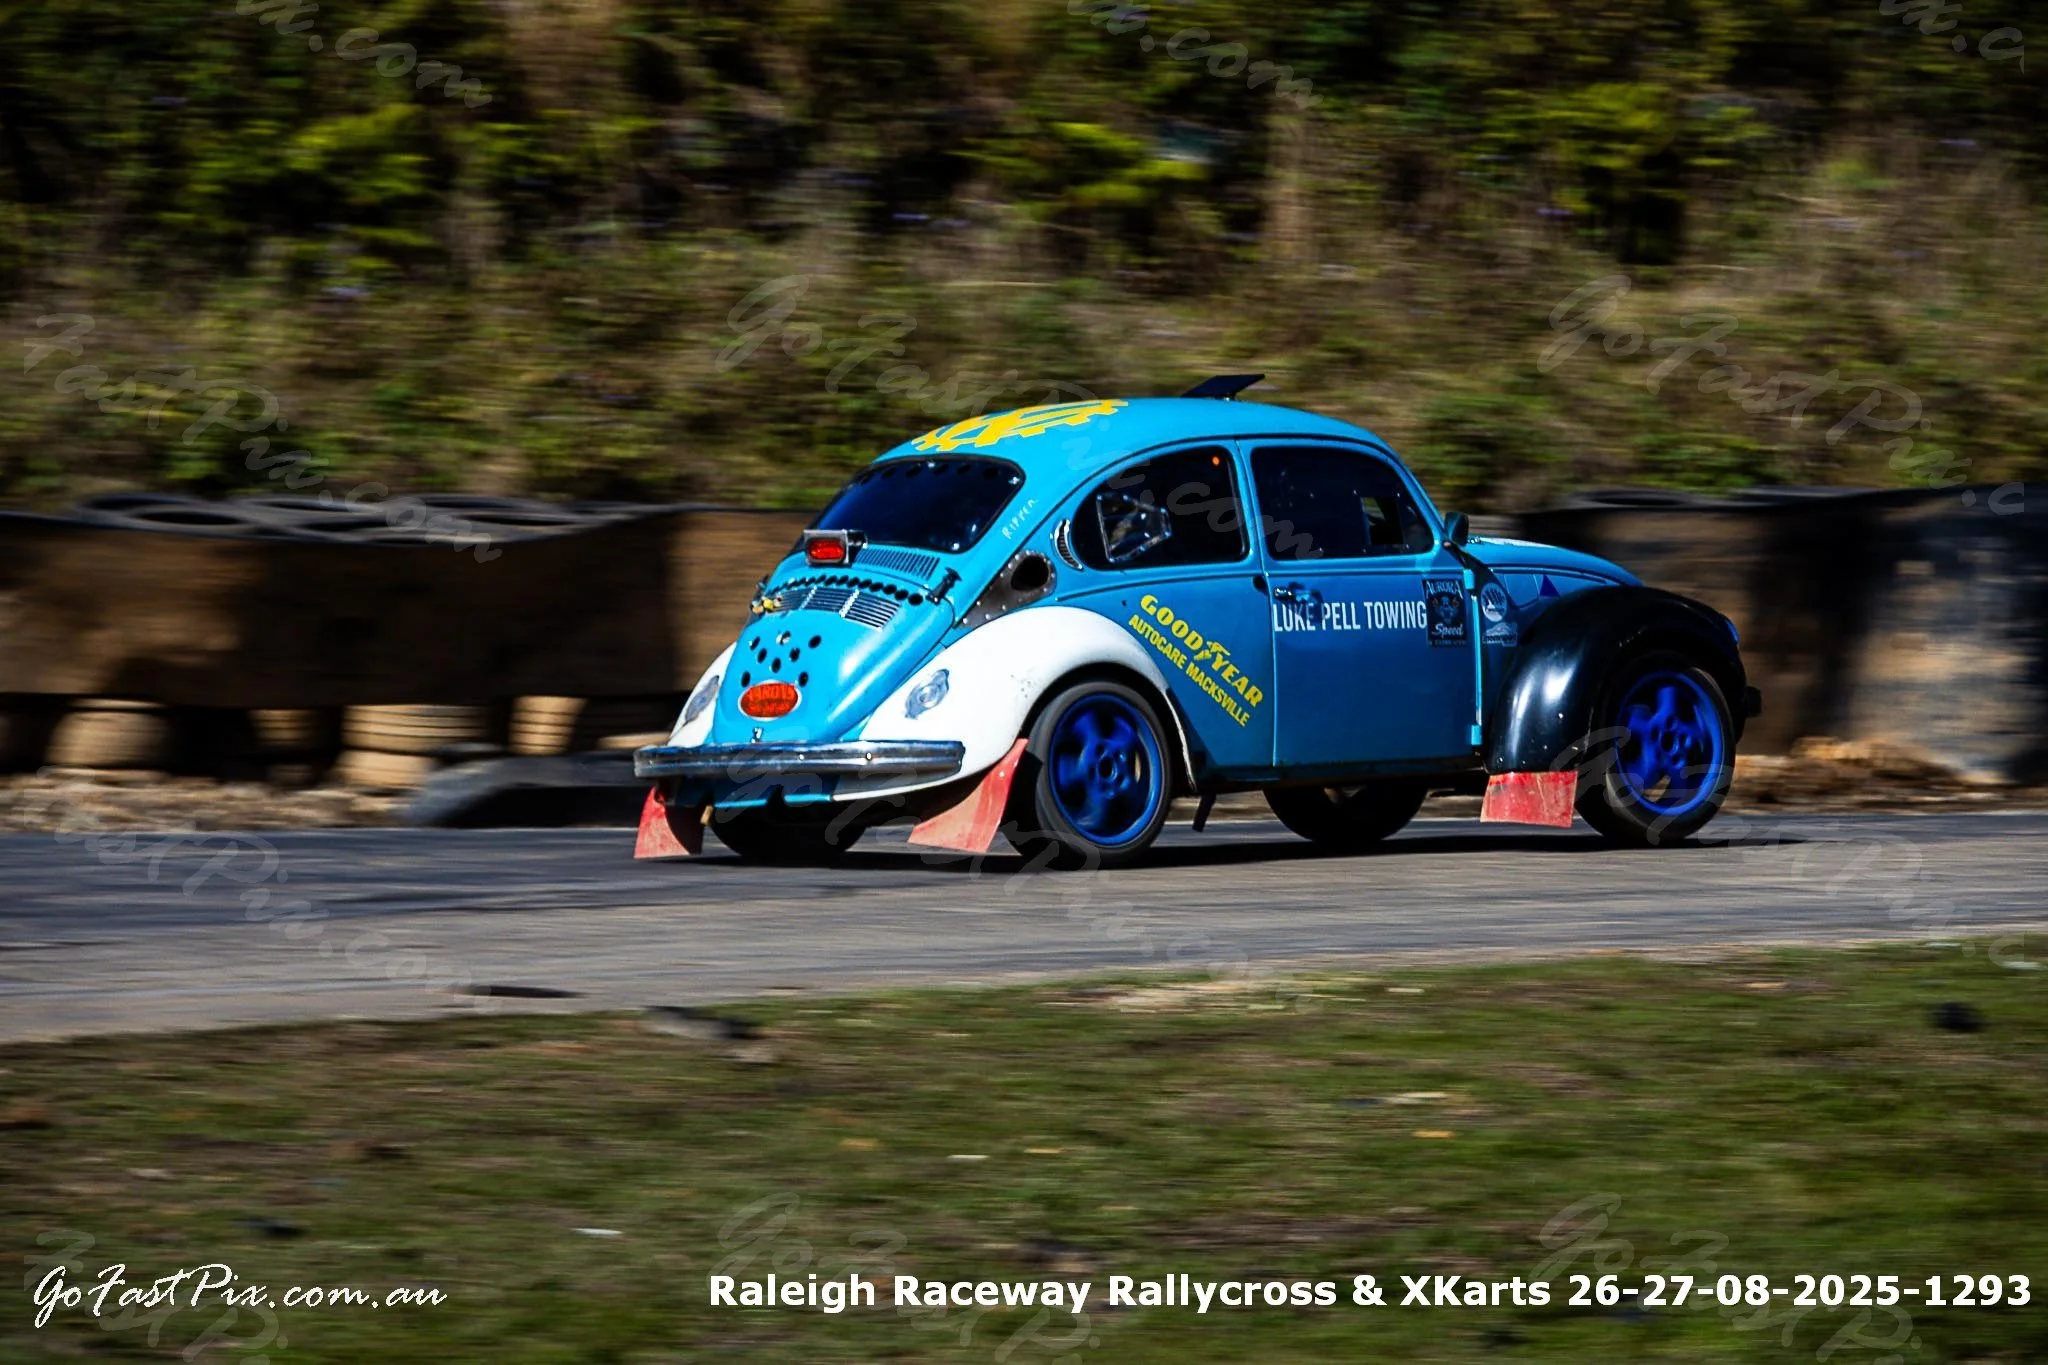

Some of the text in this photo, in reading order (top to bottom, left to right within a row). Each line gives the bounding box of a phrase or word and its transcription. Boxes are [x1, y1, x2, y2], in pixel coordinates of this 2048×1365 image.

[1128, 614, 1251, 728] AUTOCARE MACKSVILLE
[1140, 594, 1264, 708] GOODYEAR
[1272, 601, 1428, 632] LUKE PELL TOWING
